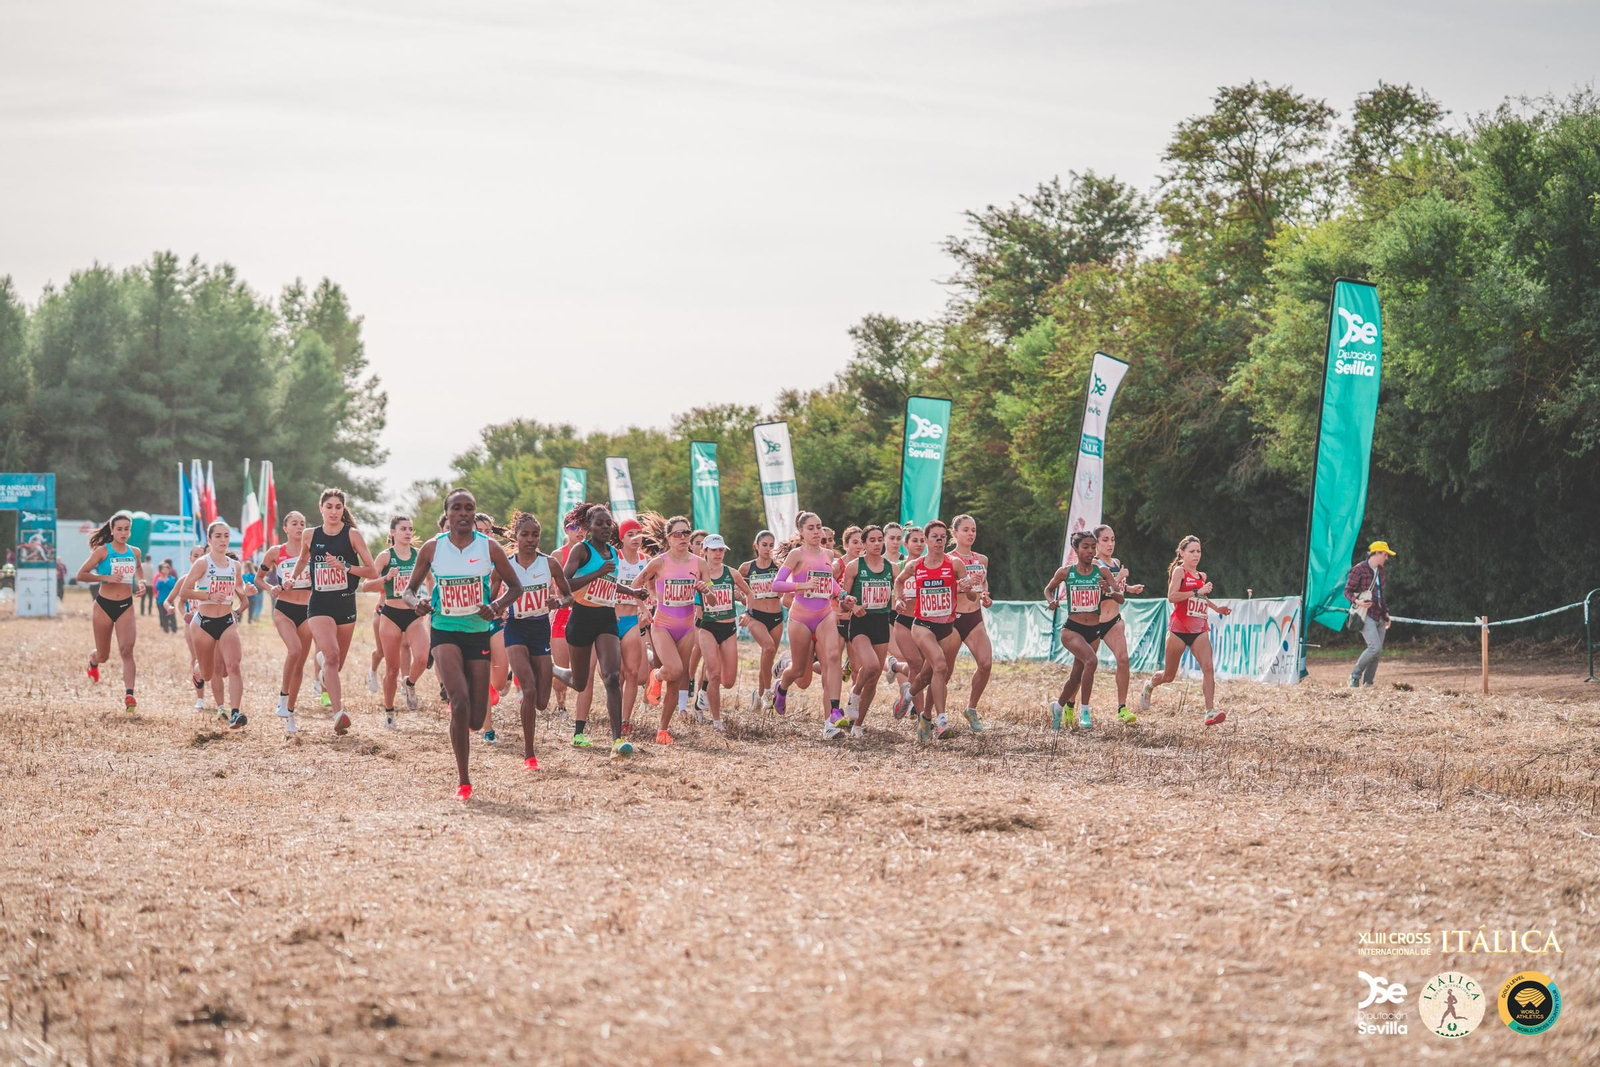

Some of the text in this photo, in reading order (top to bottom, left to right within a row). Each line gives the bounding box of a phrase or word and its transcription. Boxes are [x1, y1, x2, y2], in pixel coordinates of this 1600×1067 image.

[908, 448, 941, 460] Sevilla
[114, 565, 134, 574] 5008
[315, 568, 347, 586] VICIOSA
[441, 582, 482, 607] JEPKEMEI
[704, 590, 731, 606] CRRAL
[921, 593, 951, 611] ROBLES
